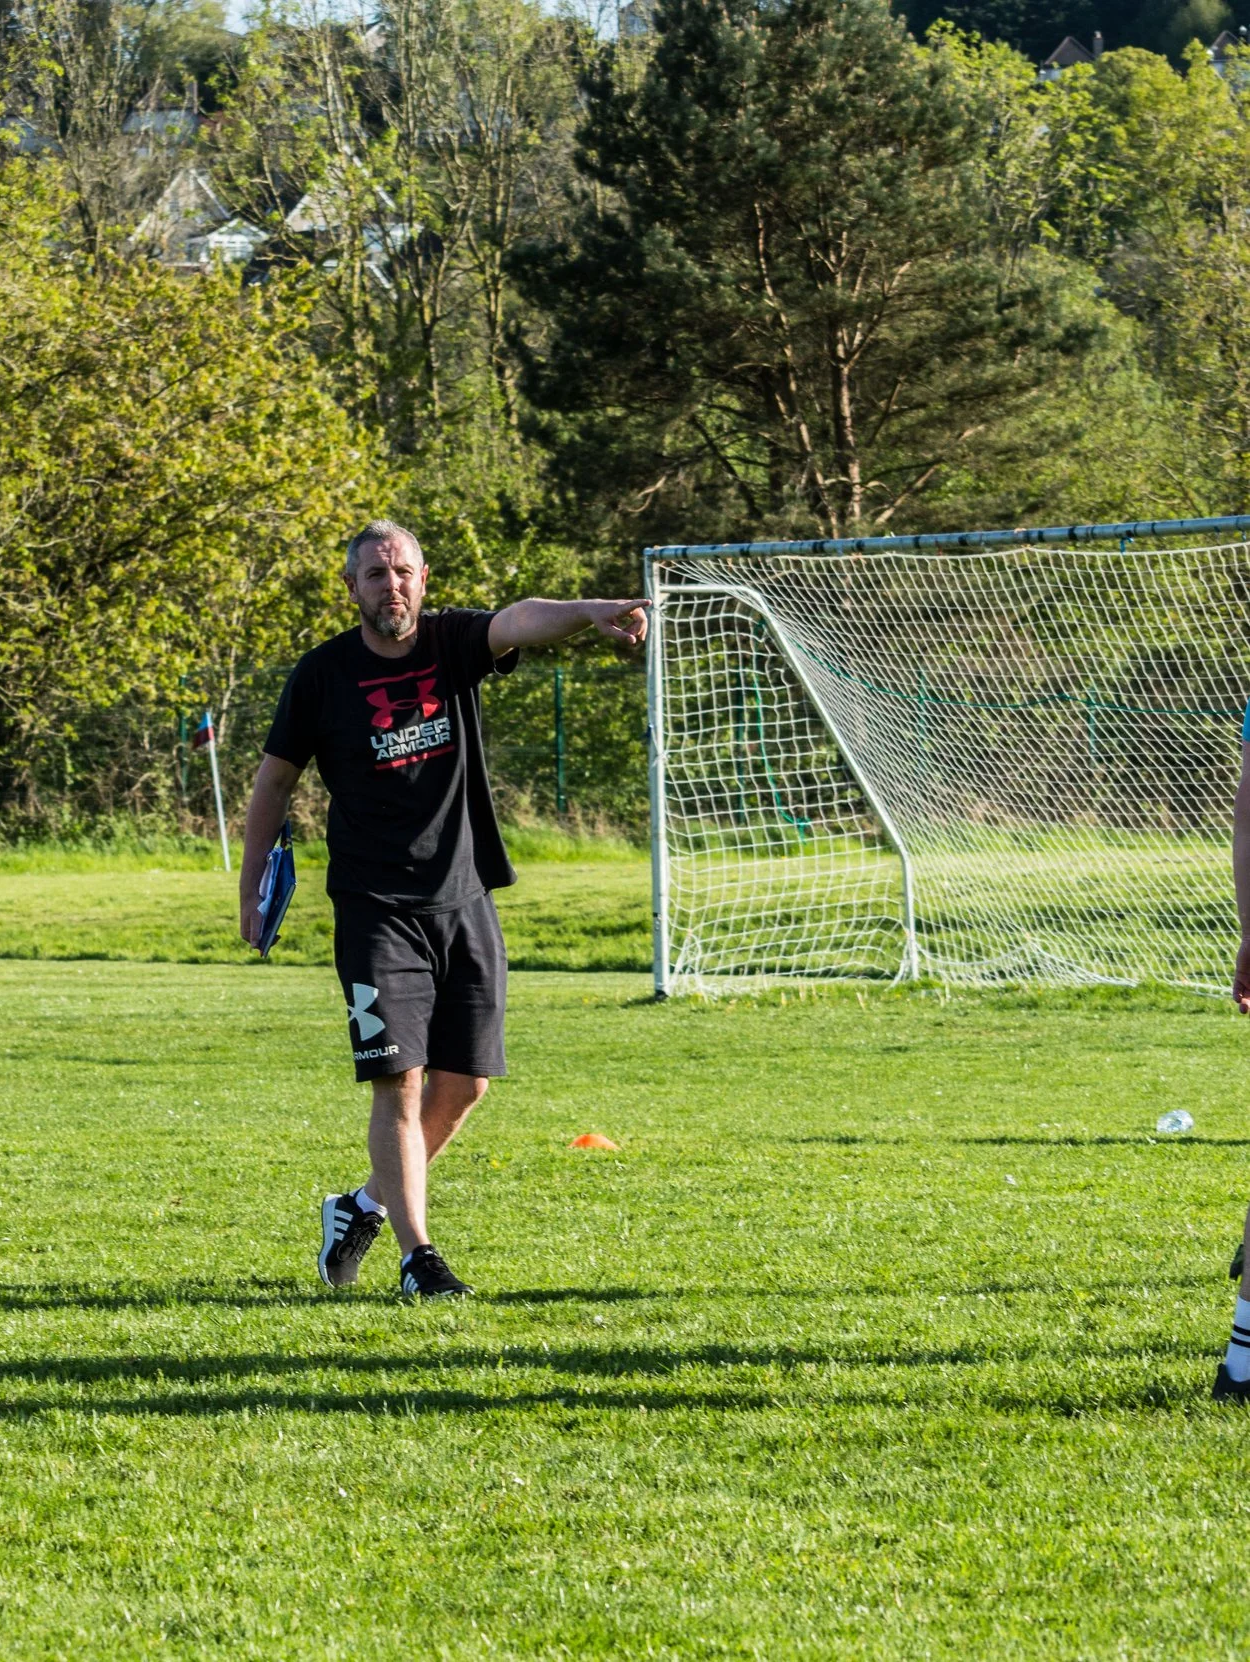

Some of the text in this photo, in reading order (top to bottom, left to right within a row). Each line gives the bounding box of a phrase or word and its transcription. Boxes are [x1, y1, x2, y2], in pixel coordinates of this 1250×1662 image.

[370, 717, 451, 749] UNDER
[376, 732, 451, 760] ARMOUR
[353, 1045, 400, 1060] RMOUR
